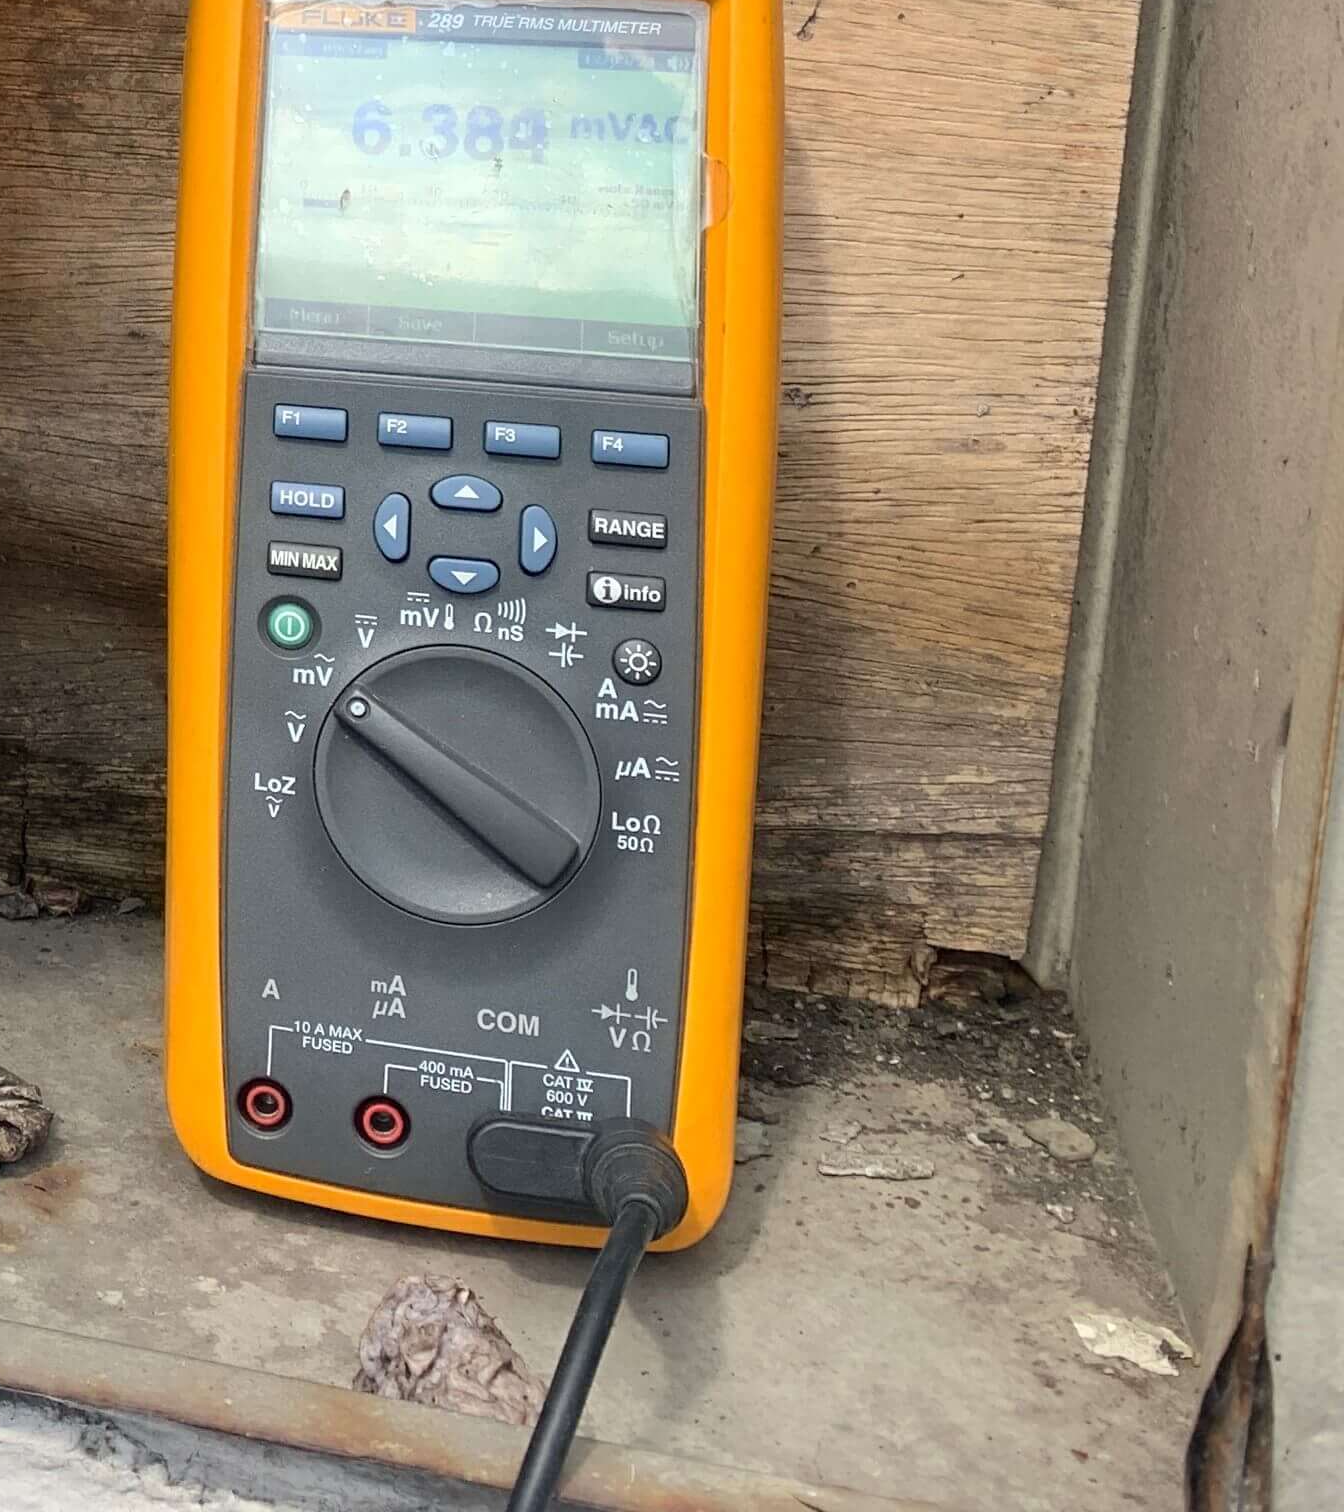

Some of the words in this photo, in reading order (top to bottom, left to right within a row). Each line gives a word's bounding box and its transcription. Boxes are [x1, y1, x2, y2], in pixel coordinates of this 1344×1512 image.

[427, 12, 465, 29] 289
[472, 14, 516, 30] TRUE
[518, 15, 555, 31] RMS
[557, 16, 663, 36] MULTIMETER
[352, 100, 549, 166] 6.384
[282, 410, 302, 426] F1
[386, 418, 408, 435] F2
[495, 427, 517, 443] F3
[602, 437, 624, 453] F4
[279, 489, 335, 510] HOLD
[594, 517, 665, 540] RANGE
[270, 549, 301, 569] MIN
[301, 551, 338, 572] MAX
[624, 584, 662, 604] info
[400, 607, 440, 628] mV
[357, 627, 375, 649] V
[497, 623, 524, 642] nS
[292, 665, 334, 687] mV
[597, 677, 618, 699] A
[595, 699, 640, 722] mA
[287, 721, 306, 743] V
[253, 772, 297, 795] LoZ
[261, 978, 280, 1000] A
[370, 975, 407, 997] mA
[293, 1019, 311, 1034] 10
[314, 1023, 326, 1037] A
[328, 1024, 363, 1042] MAX
[476, 1007, 541, 1038] COM
[302, 1036, 353, 1055] FUSED
[609, 1025, 627, 1049] V
[418, 1059, 446, 1076] 400
[449, 1065, 475, 1081] mA
[420, 1074, 473, 1095] FUSED
[542, 1073, 574, 1089] CAT
[576, 1078, 594, 1093] IV
[545, 1089, 574, 1106] 600
[577, 1093, 588, 1107] V
[541, 1105, 574, 1120] CAT
